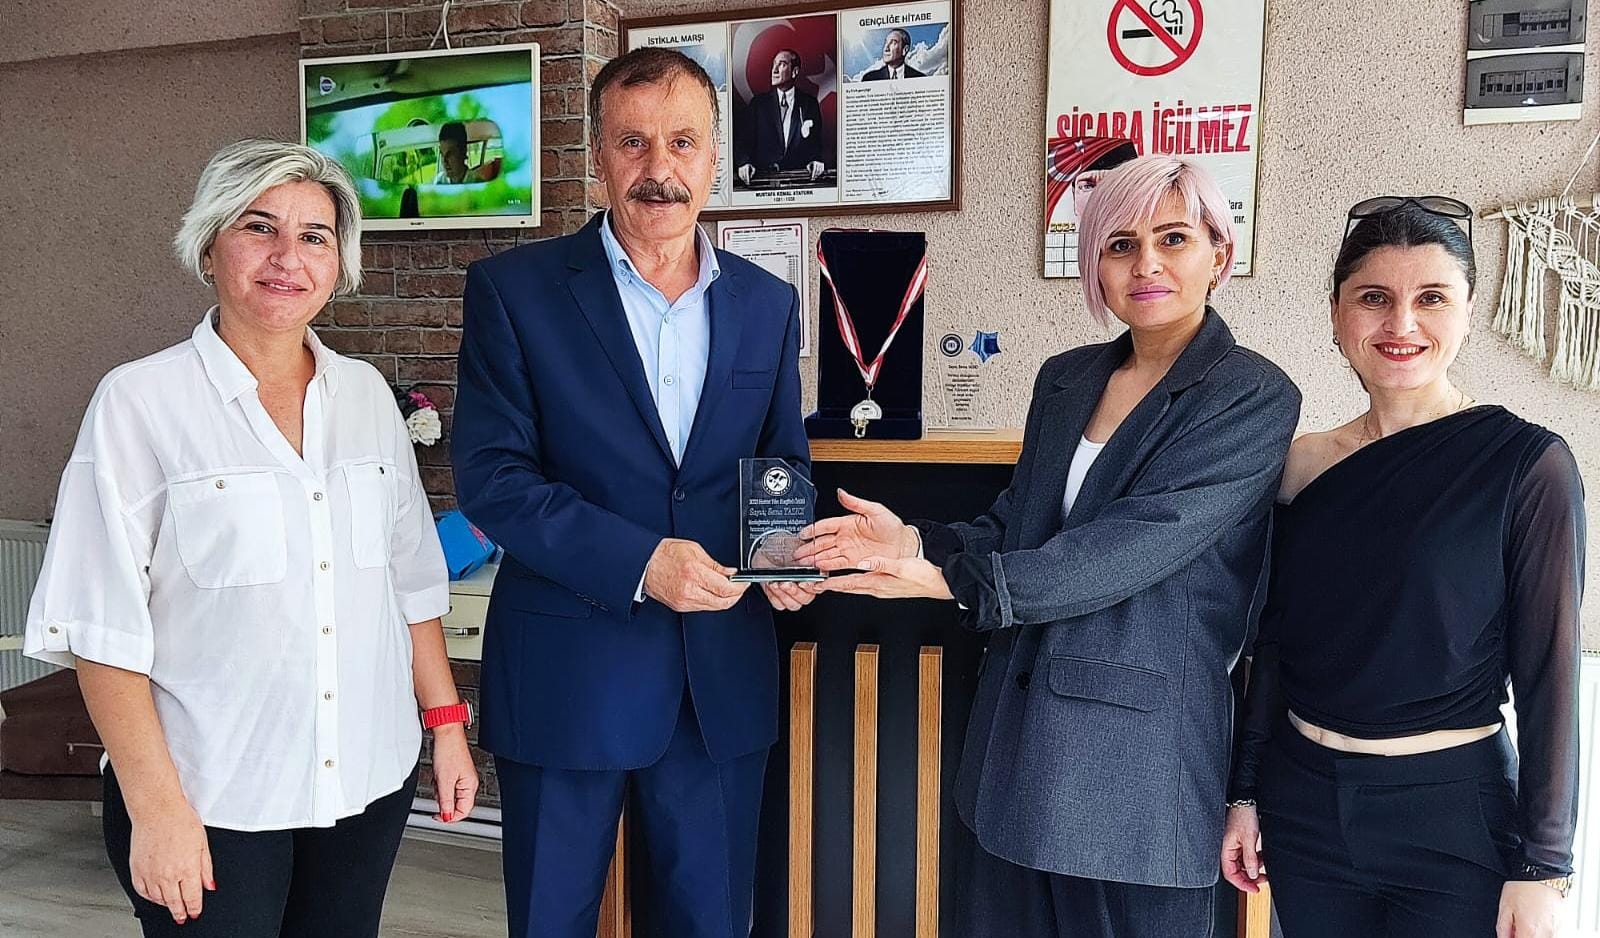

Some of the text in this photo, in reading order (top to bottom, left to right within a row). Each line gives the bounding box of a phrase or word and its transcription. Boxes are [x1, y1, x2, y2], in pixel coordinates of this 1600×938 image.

[859, 12, 932, 27] GENÇLİĞE HİTABE
[648, 33, 705, 45] İSTİKLAL MARŞI
[1050, 223, 1076, 233] 2024
